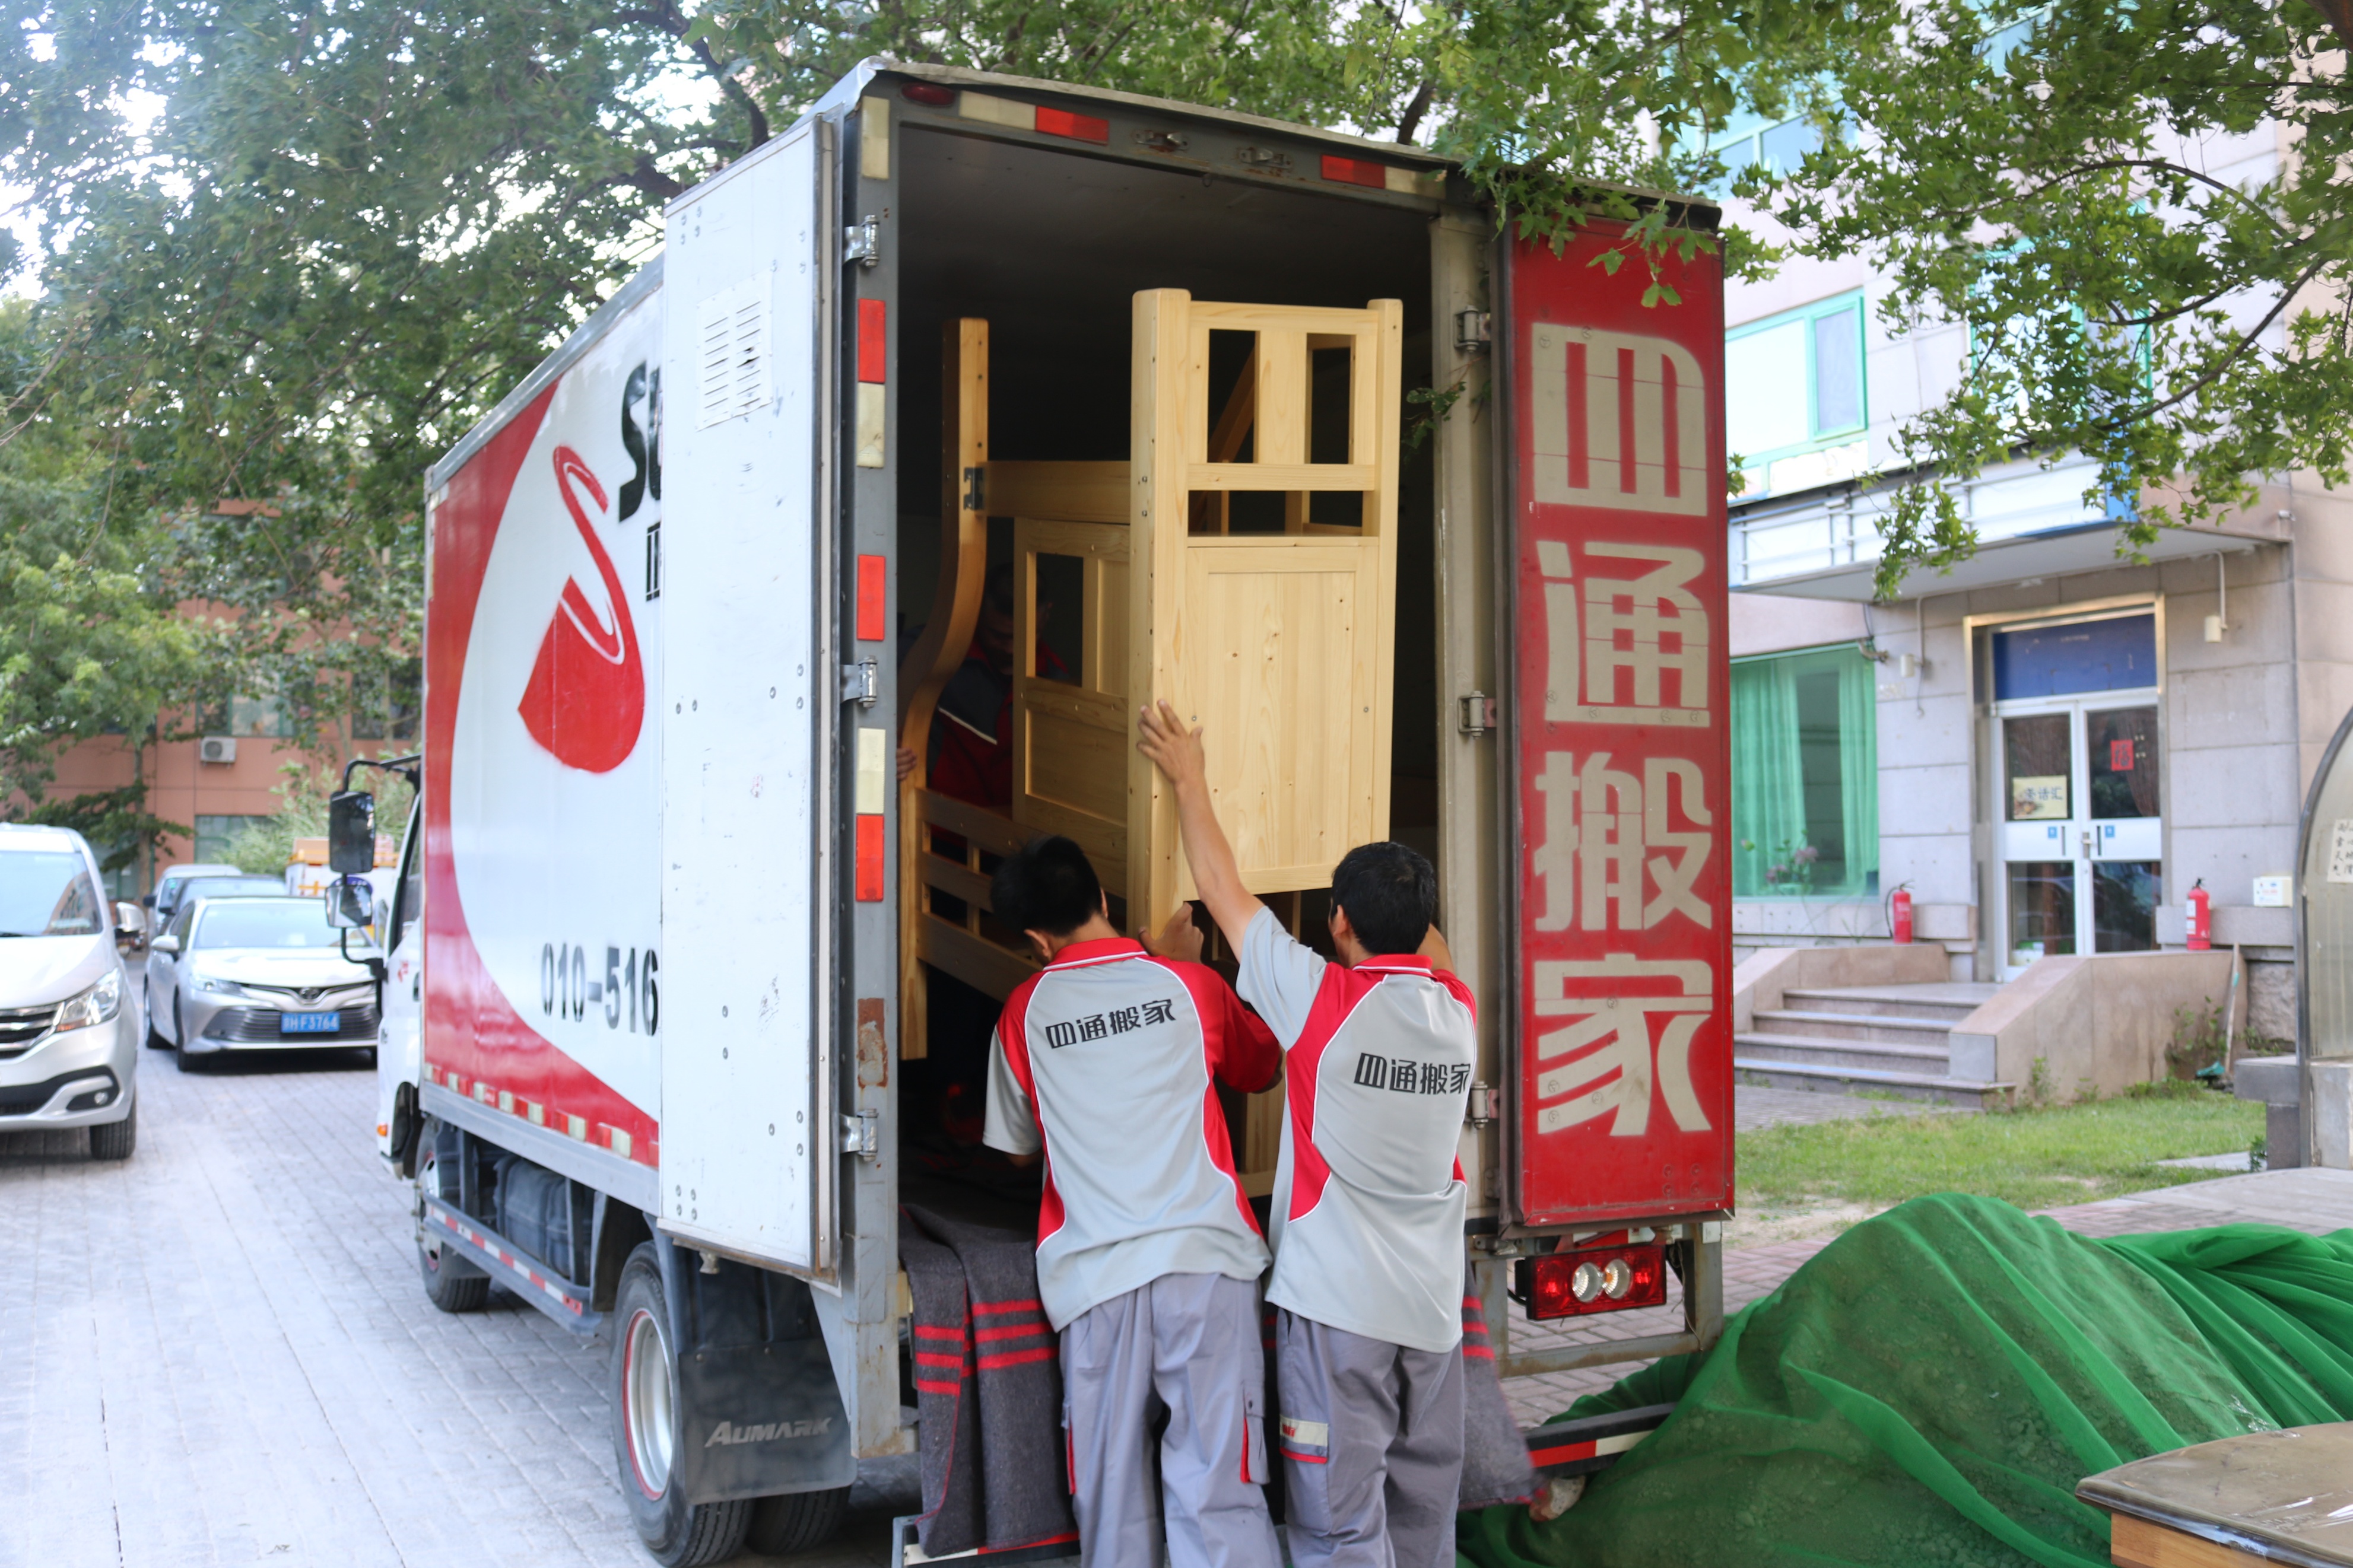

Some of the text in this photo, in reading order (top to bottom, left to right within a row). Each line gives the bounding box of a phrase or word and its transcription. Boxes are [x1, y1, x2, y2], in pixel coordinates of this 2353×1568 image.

[1532, 322, 1713, 1137] 四通搬家
[541, 942, 658, 1037] 010-516
[1045, 999, 1176, 1049] 四通搬家
[1354, 1052, 1471, 1095] 四通搬家
[704, 1417, 832, 1448] AUMARK
